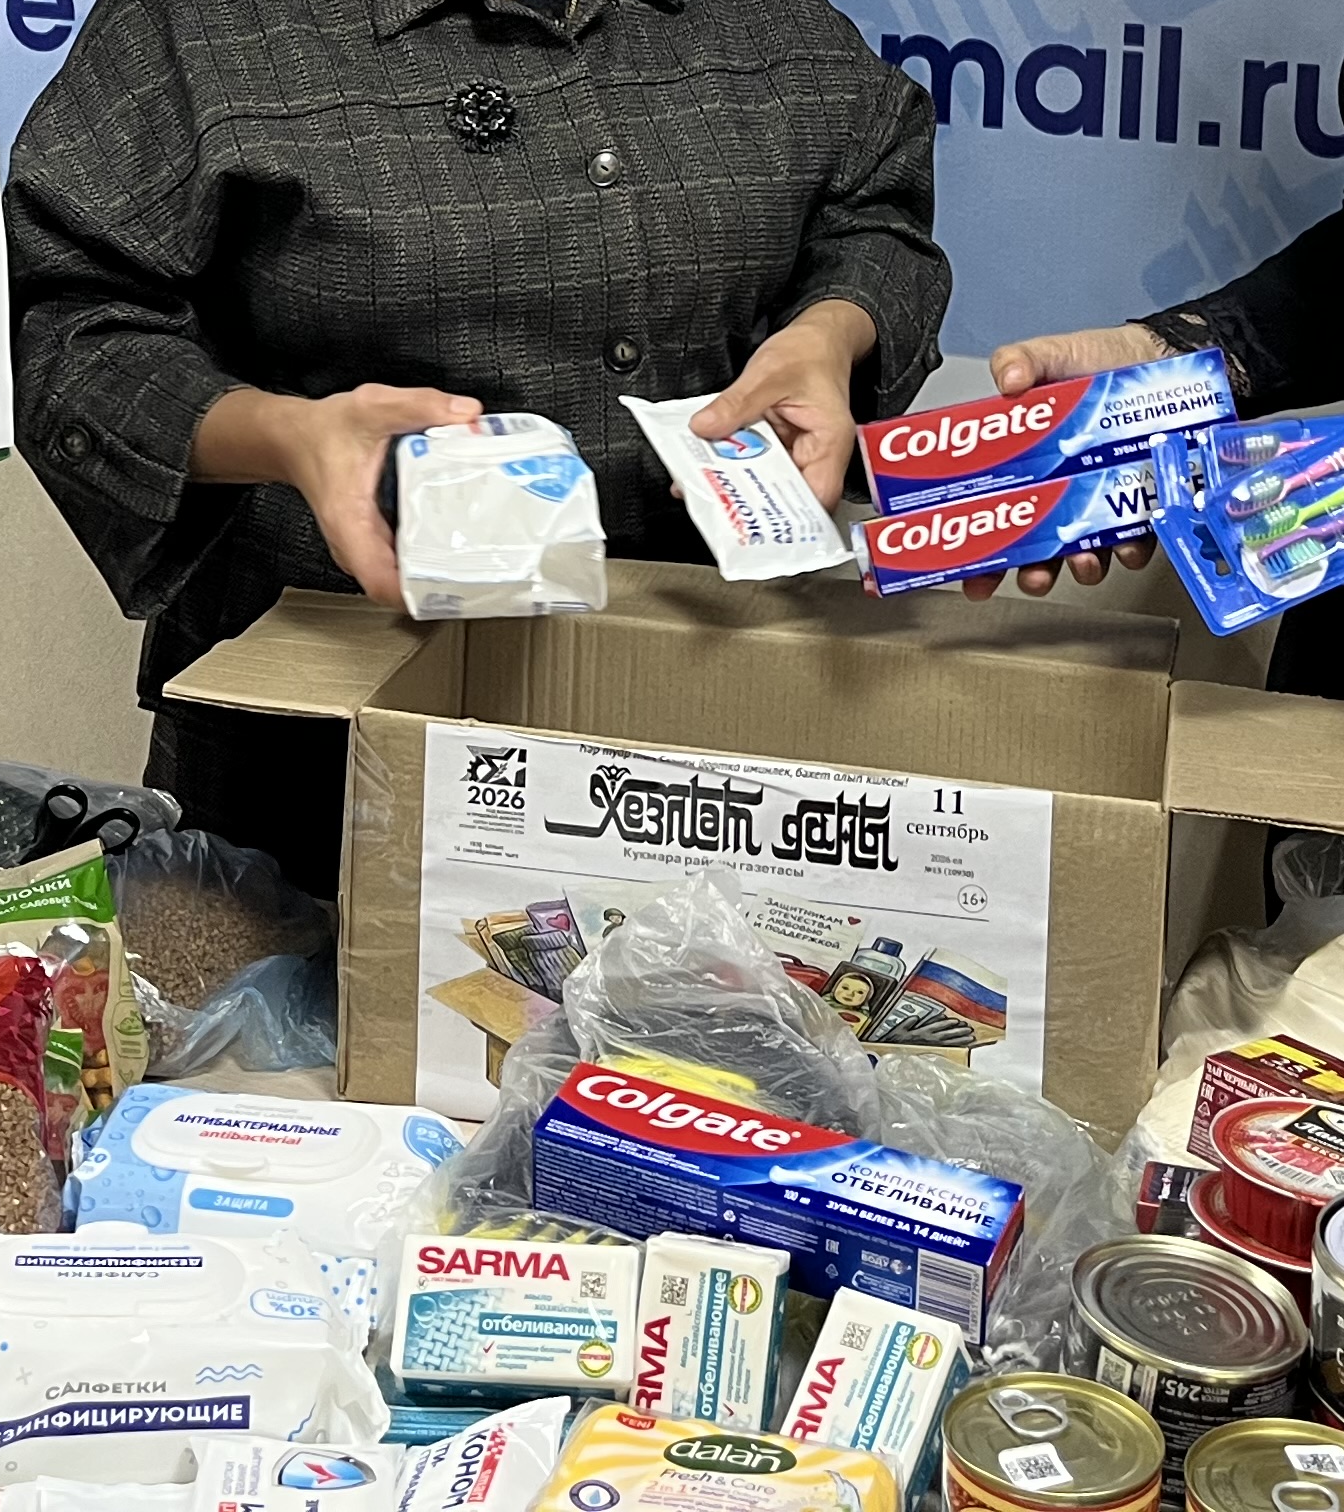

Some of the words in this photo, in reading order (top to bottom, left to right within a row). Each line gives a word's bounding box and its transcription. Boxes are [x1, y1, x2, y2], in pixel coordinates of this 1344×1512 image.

[1099, 391, 1225, 430] ОТБЕЛИВАНИЕ
[1103, 379, 1212, 413] КОМПЛЕКСНОЕ
[878, 396, 1057, 463] Colgate
[876, 495, 1038, 556] Colgate
[833, 771, 863, 786] алып
[467, 785, 526, 810] 2026
[933, 787, 965, 816] 11
[906, 821, 990, 844] сентябрь
[624, 846, 682, 865] Кукмара
[739, 860, 805, 878] газетасы
[764, 896, 844, 926] ЗАЩИТНИКАМ
[961, 891, 986, 906] 16+
[767, 915, 824, 937] ЛЮБОВЬЮ
[768, 908, 833, 932] ОТЕЧЕСТВА
[173, 1112, 342, 1138] АНТИБАКТЕРИАЛЬНЫЕ
[574, 1073, 802, 1154] Colgate
[197, 1128, 302, 1146] antibacterial
[830, 1170, 996, 1230] ОТБЕЛИВАНИЕ
[847, 1162, 990, 1212] КОМПЛЕКСНОЕ
[212, 1194, 269, 1212] ЗАЩИТА
[825, 1198, 858, 1218] ЗУБЫ
[858, 1204, 893, 1227] БЕЛЕЕ
[893, 1214, 911, 1231] ЗА
[912, 1222, 930, 1239] 14
[416, 1246, 570, 1281] SARMA
[480, 1317, 616, 1341] отбеливающее
[699, 1270, 727, 1417] отбеливающее
[634, 1315, 672, 1410] RMA
[44, 1380, 168, 1401] САЛФЕТКИ
[789, 1356, 846, 1442] RMA
[1164, 1378, 1203, 1404] 245
[669, 1438, 782, 1472] dalan
[659, 1467, 713, 1484] Fresh
[715, 1473, 726, 1486] &
[730, 1476, 777, 1495] Care
